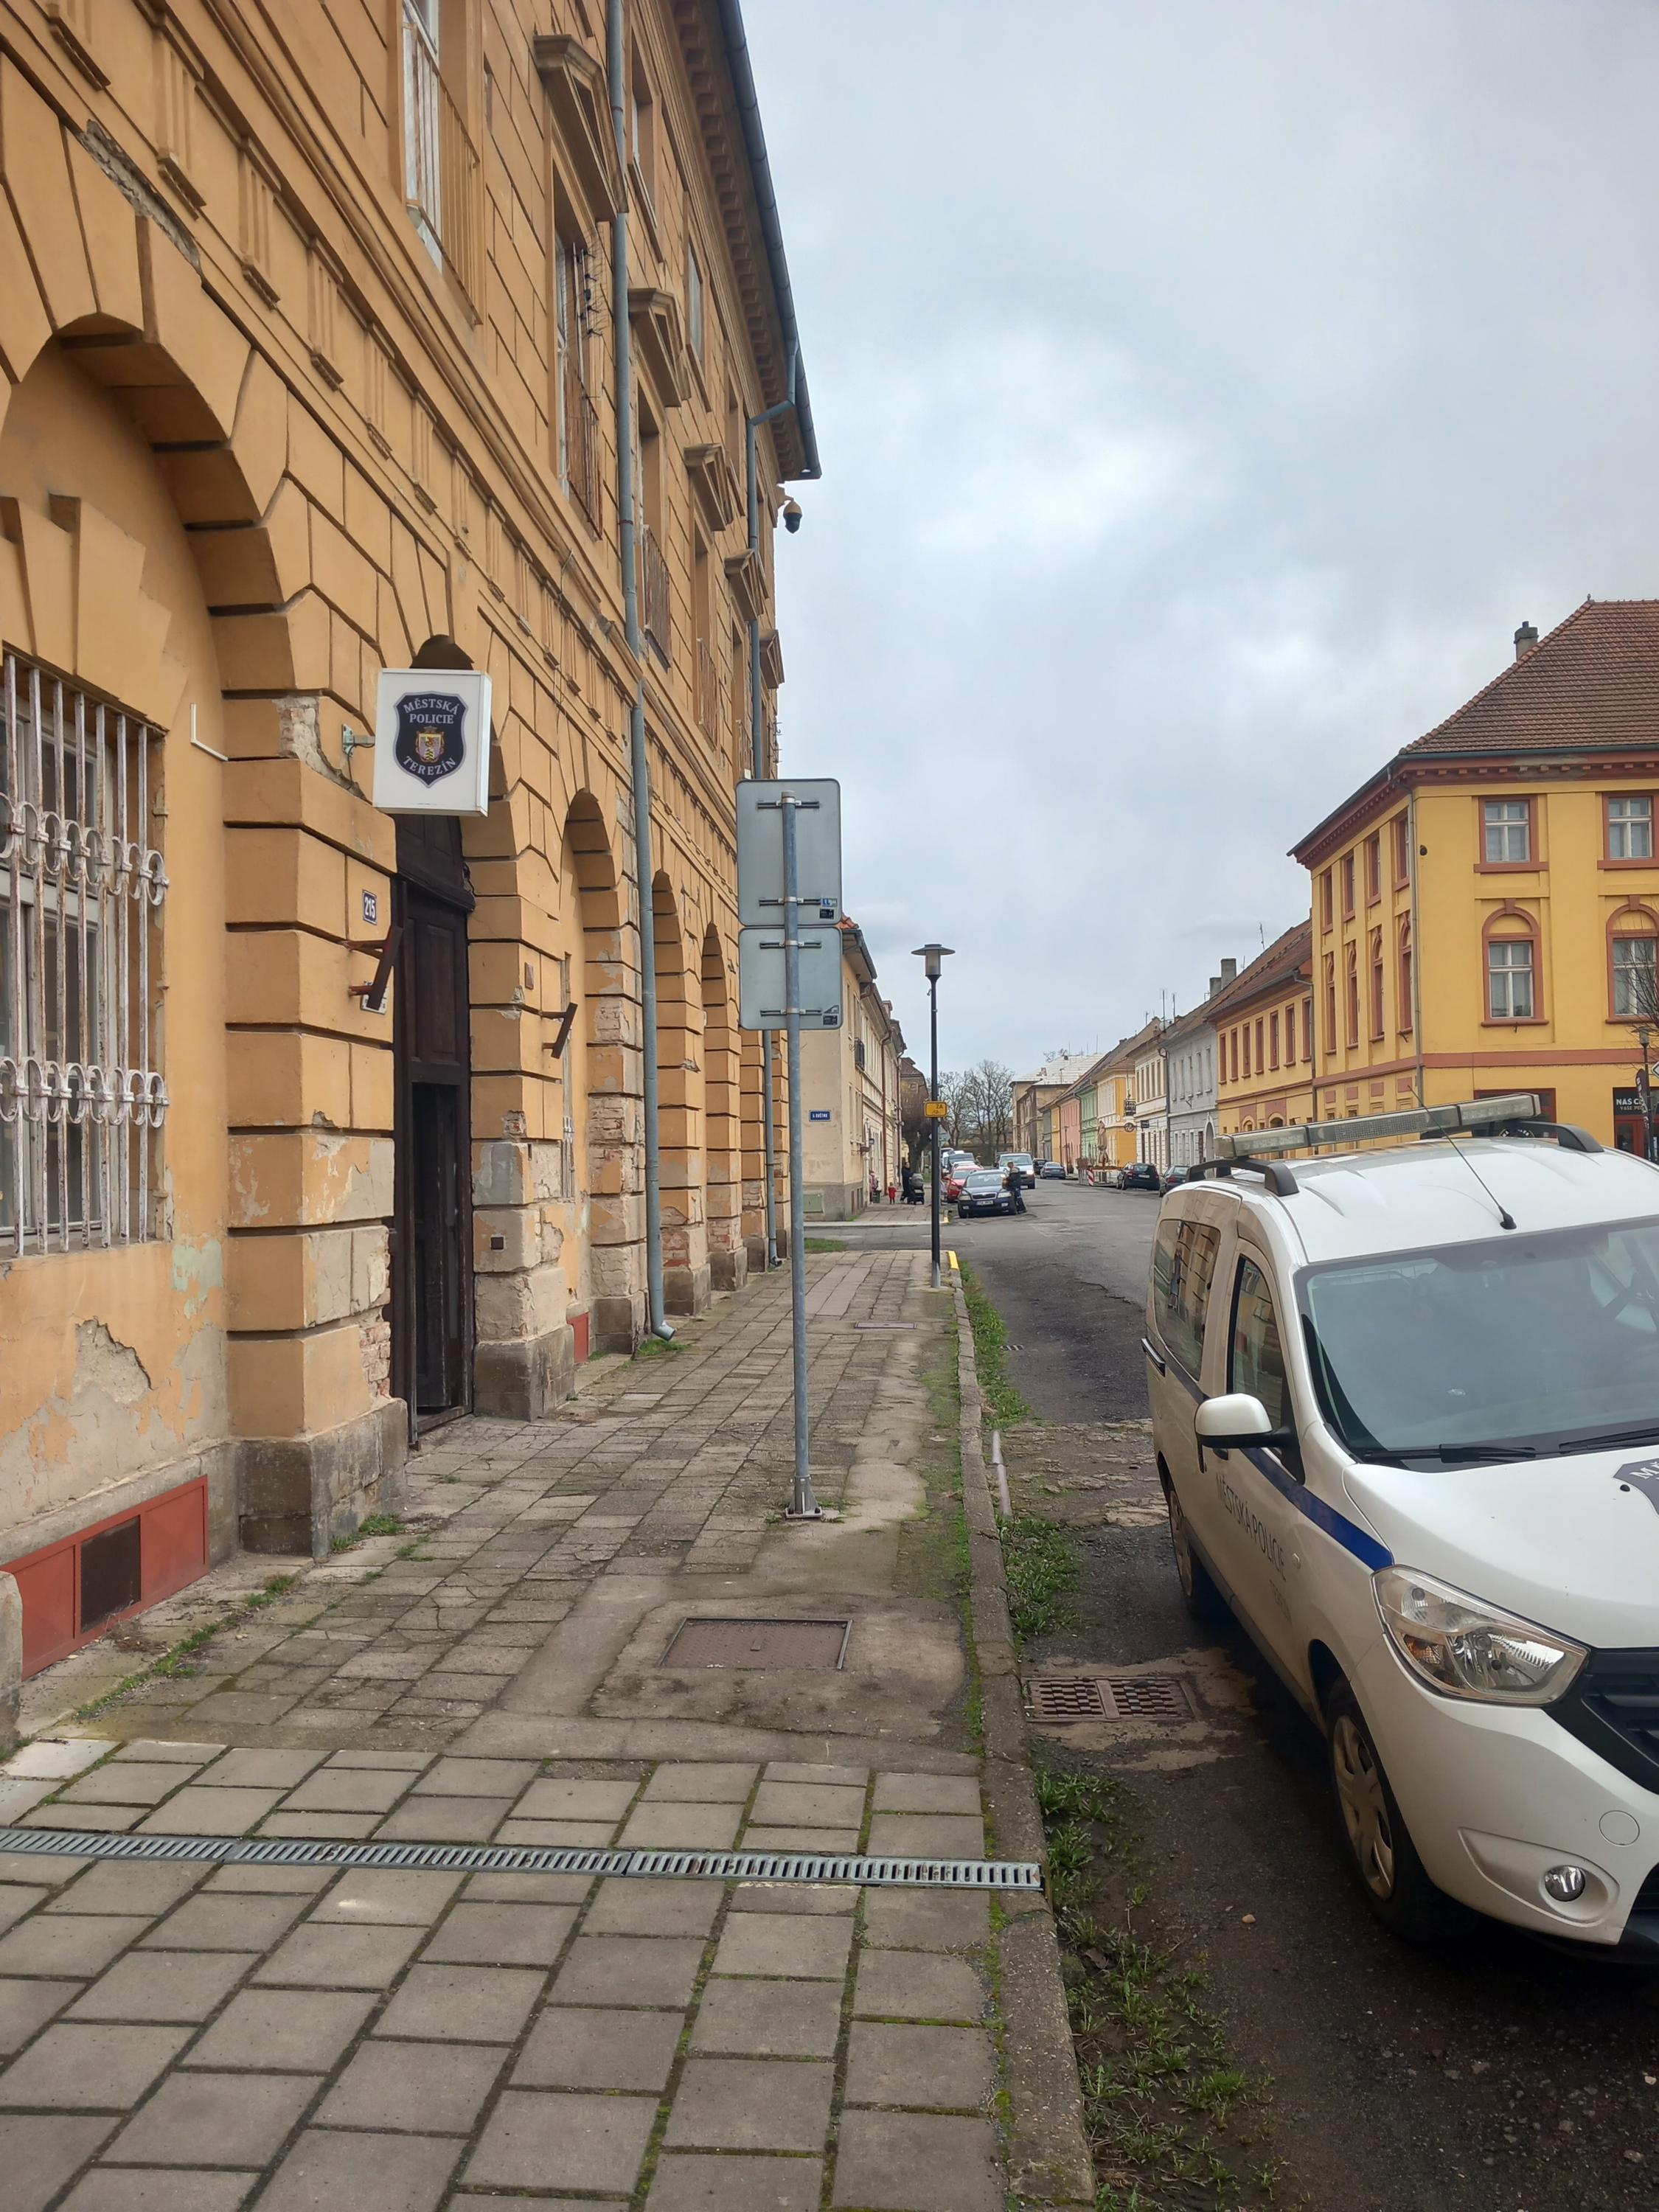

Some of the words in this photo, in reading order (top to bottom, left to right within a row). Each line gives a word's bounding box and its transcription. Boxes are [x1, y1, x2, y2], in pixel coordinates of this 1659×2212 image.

[403, 698, 460, 715] MĚSTSKÁ
[409, 713, 454, 725] POLICIE
[403, 755, 457, 776] TEREZÍN
[364, 896, 375, 919] 215
[1252, 1514, 1286, 1582] POLICIE
